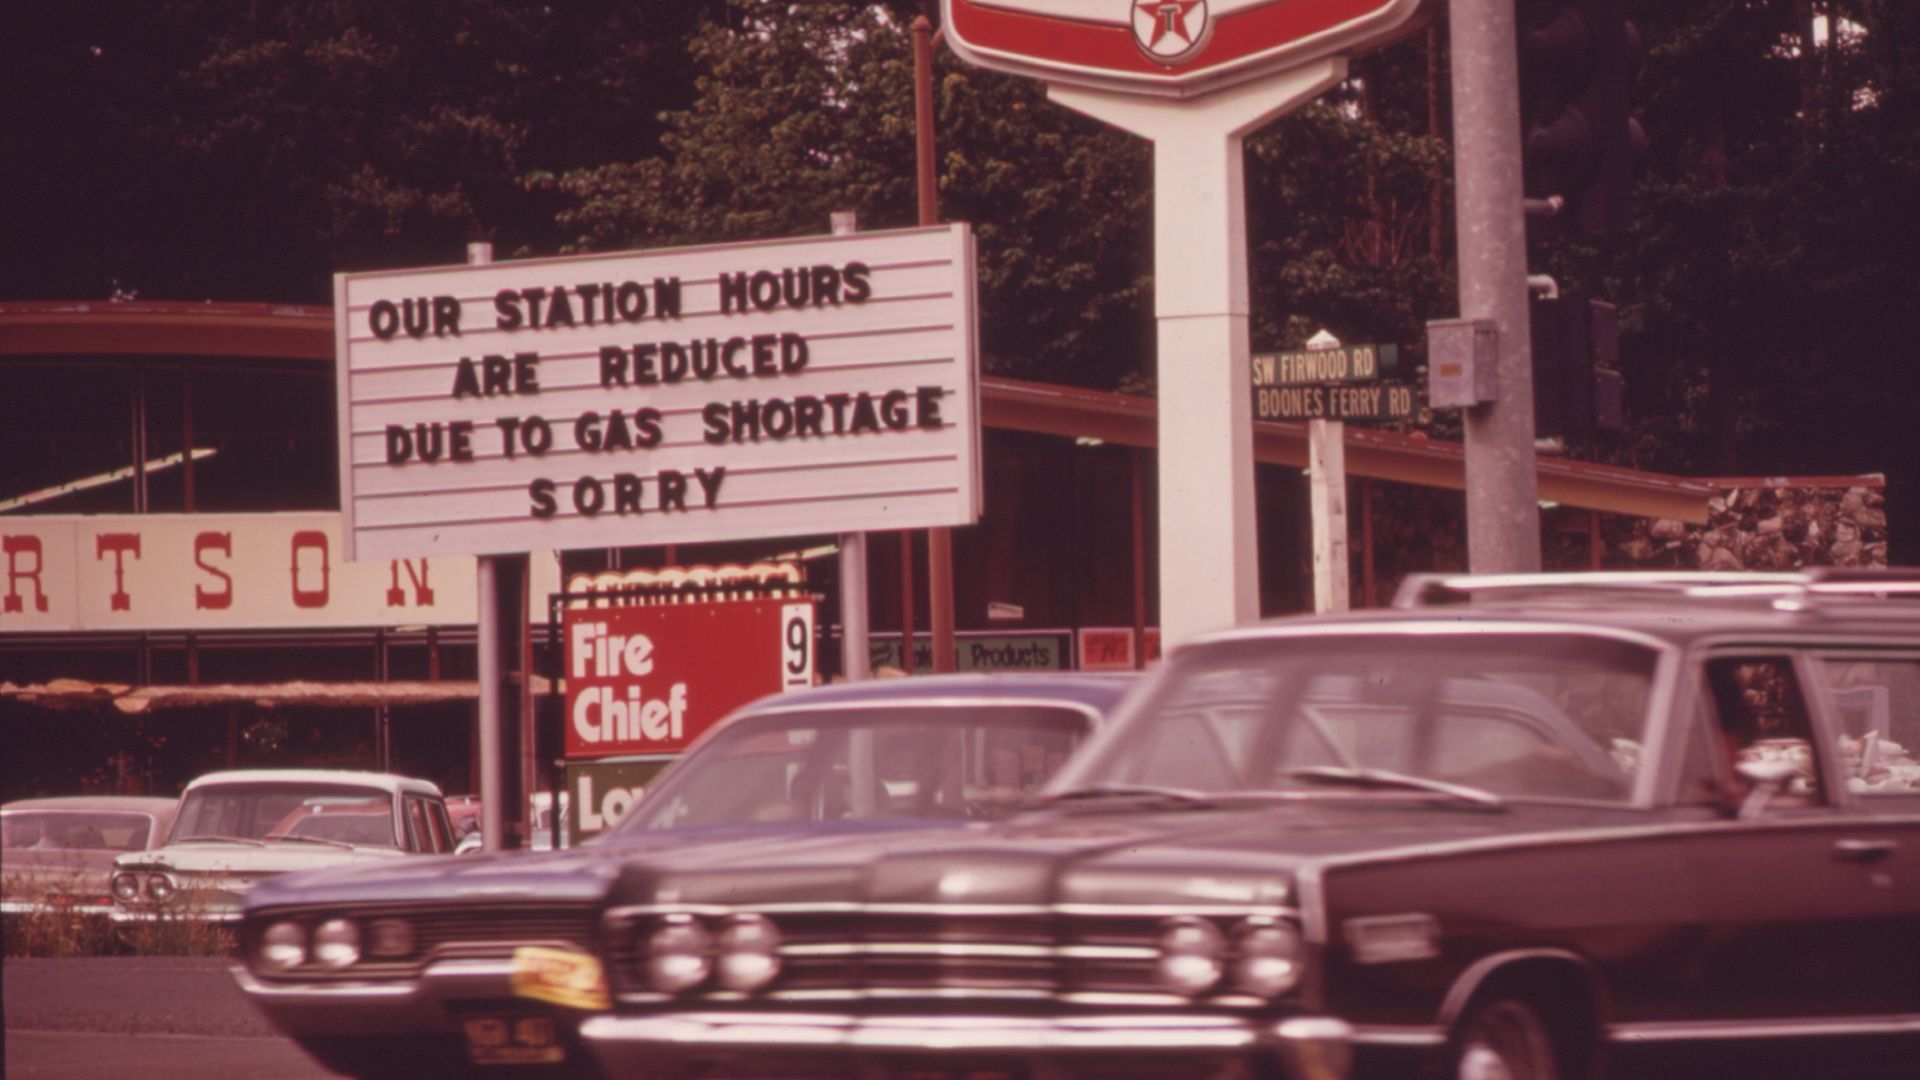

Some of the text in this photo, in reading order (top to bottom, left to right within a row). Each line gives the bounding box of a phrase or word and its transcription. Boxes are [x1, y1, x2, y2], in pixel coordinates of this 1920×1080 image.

[369, 262, 871, 341] OUR STATION HOURS
[451, 333, 809, 400] ARE REDUCED
[1252, 347, 1375, 386] SW FIRWOOD RD
[385, 386, 945, 468] DUE TO GAS SHORTAGE
[1258, 385, 1411, 417] BOONES FERRY RD
[528, 467, 726, 520] SORRY
[571, 622, 654, 678] Fire
[787, 617, 808, 675] 9
[970, 641, 1051, 668] Products
[573, 682, 687, 743] Chief
[577, 775, 645, 832] Lo
